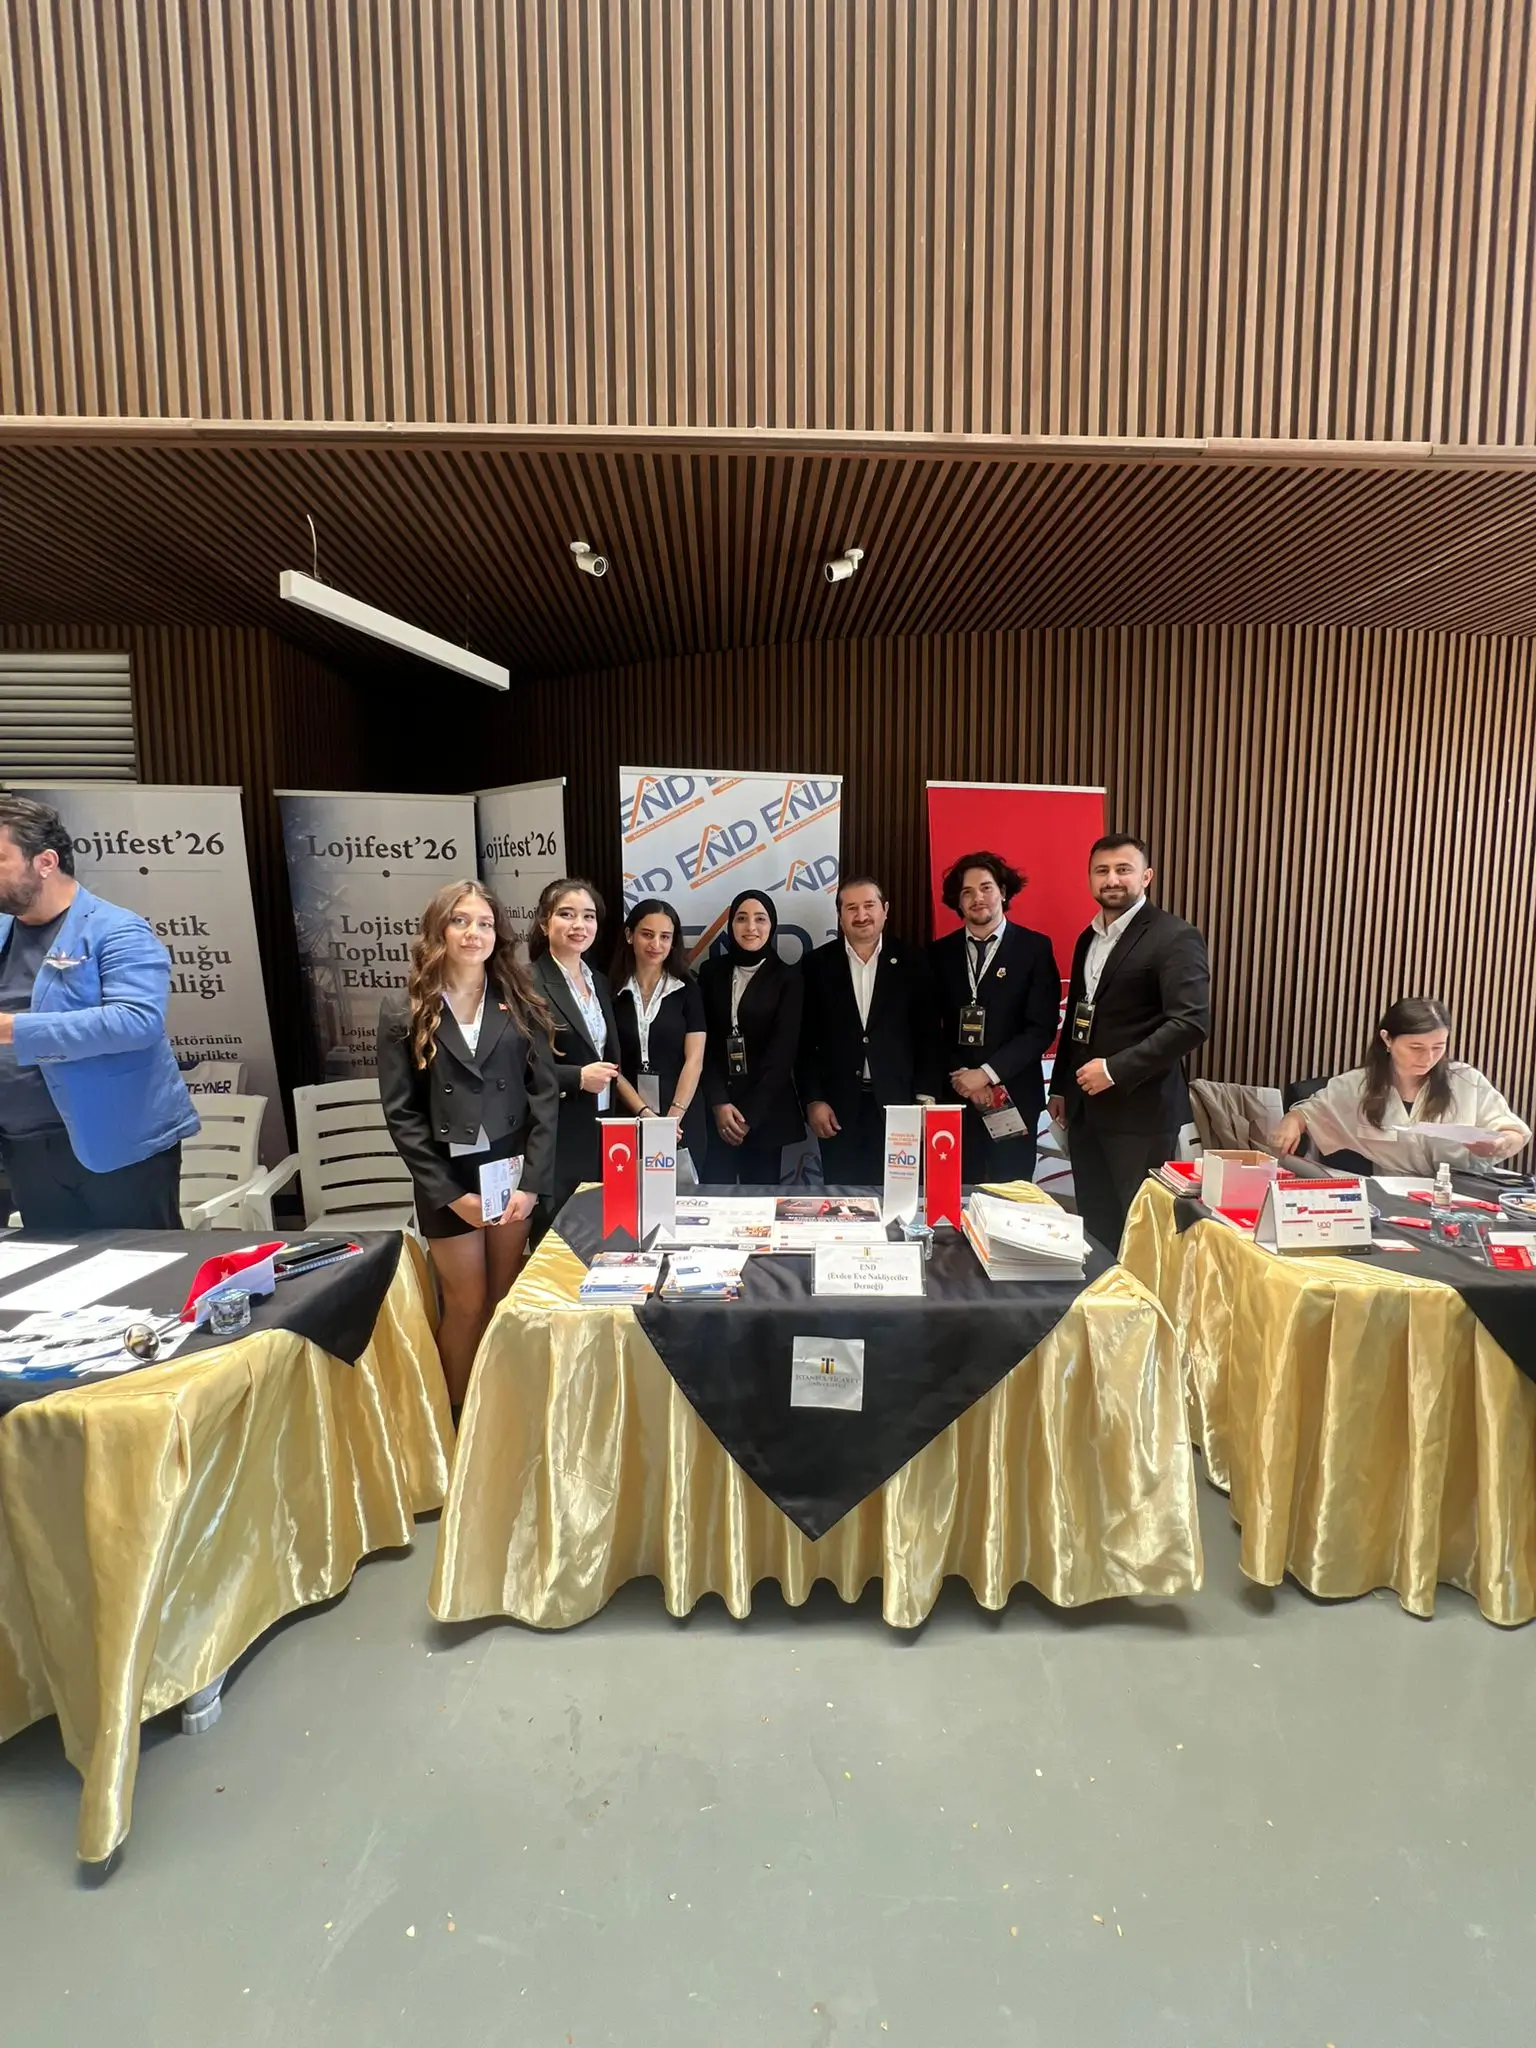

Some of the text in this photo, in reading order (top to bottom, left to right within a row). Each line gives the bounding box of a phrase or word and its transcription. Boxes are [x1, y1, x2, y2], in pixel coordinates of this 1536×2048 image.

[760, 781, 838, 833] END
[73, 830, 225, 862] ojifest’26
[675, 819, 757, 881] END
[340, 915, 422, 941] Lojisti
[645, 1156, 675, 1168] END
[888, 1153, 916, 1165] END
